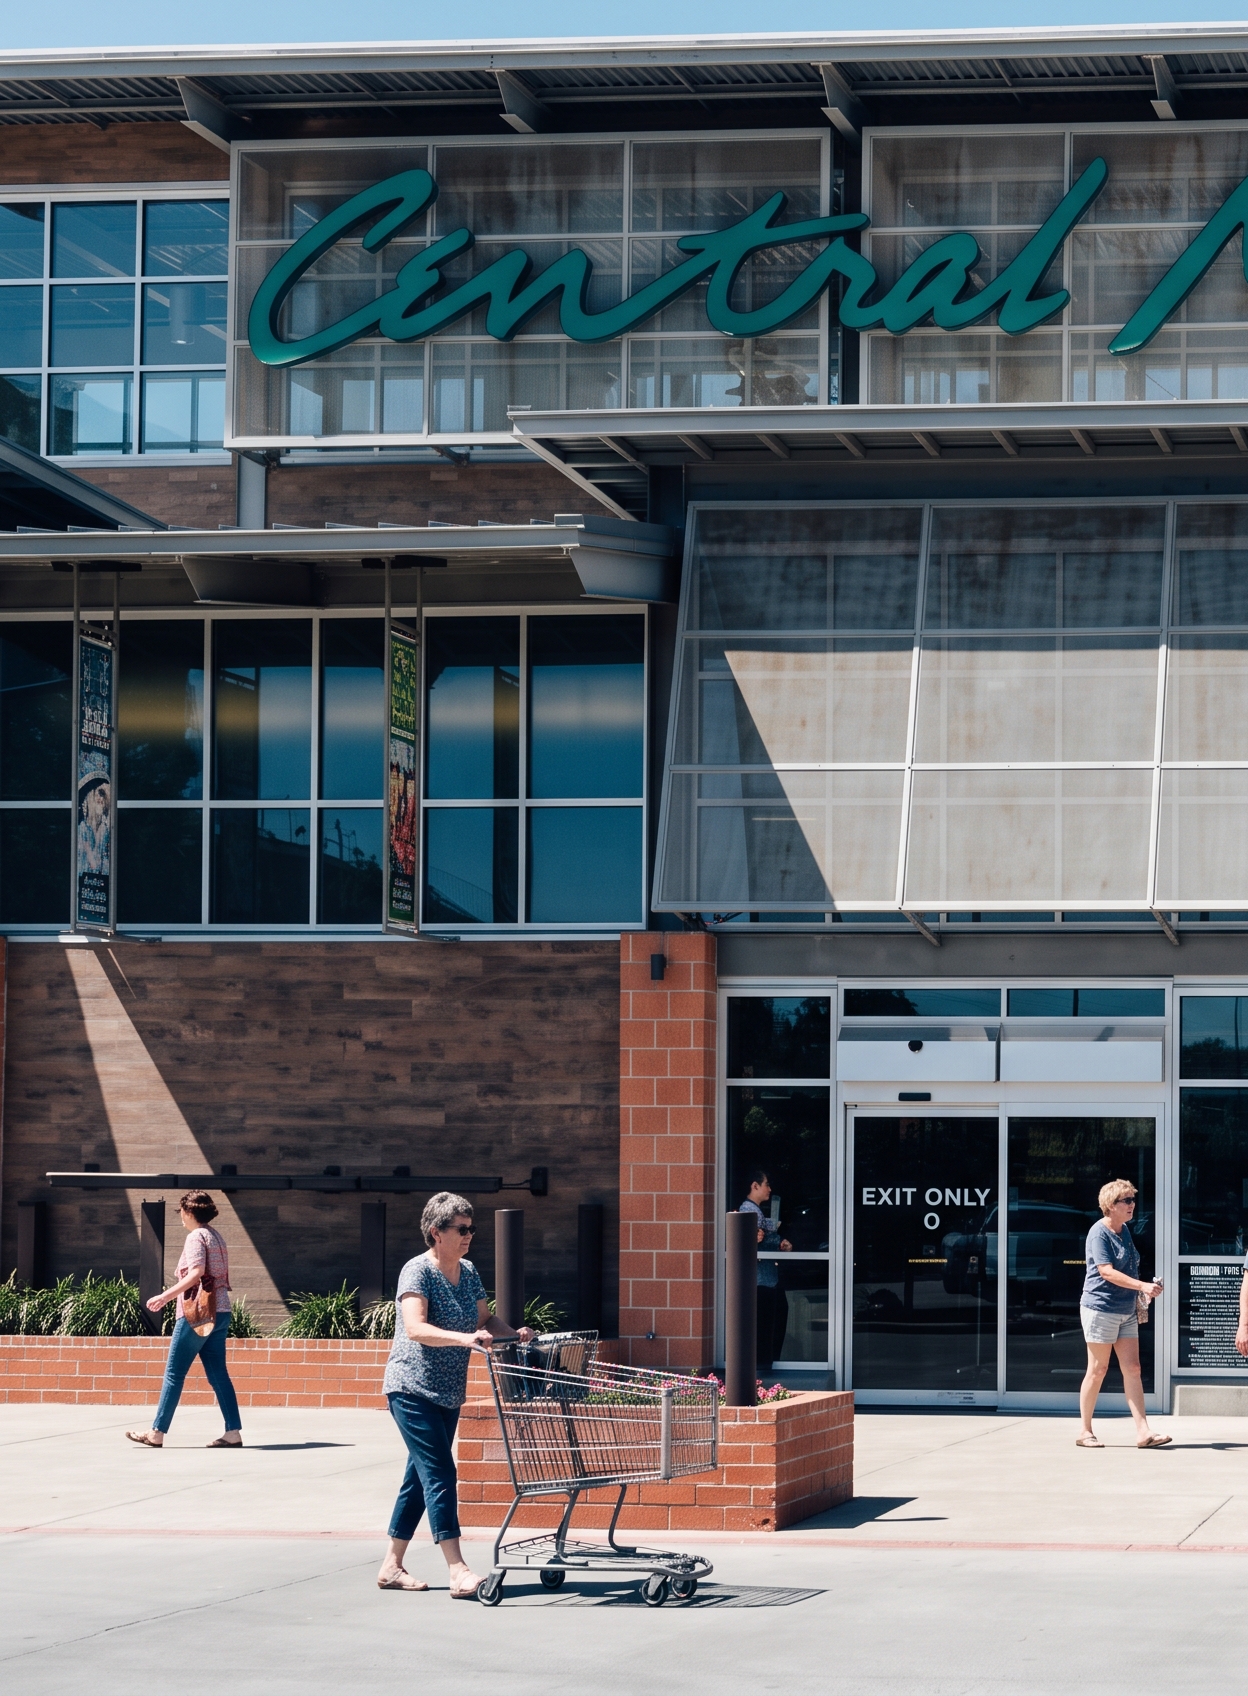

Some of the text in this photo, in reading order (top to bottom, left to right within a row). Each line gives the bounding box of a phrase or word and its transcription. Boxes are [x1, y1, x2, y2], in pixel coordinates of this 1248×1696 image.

[248, 156, 1108, 368] Central
[862, 1187, 991, 1206] EXIT ONLY
